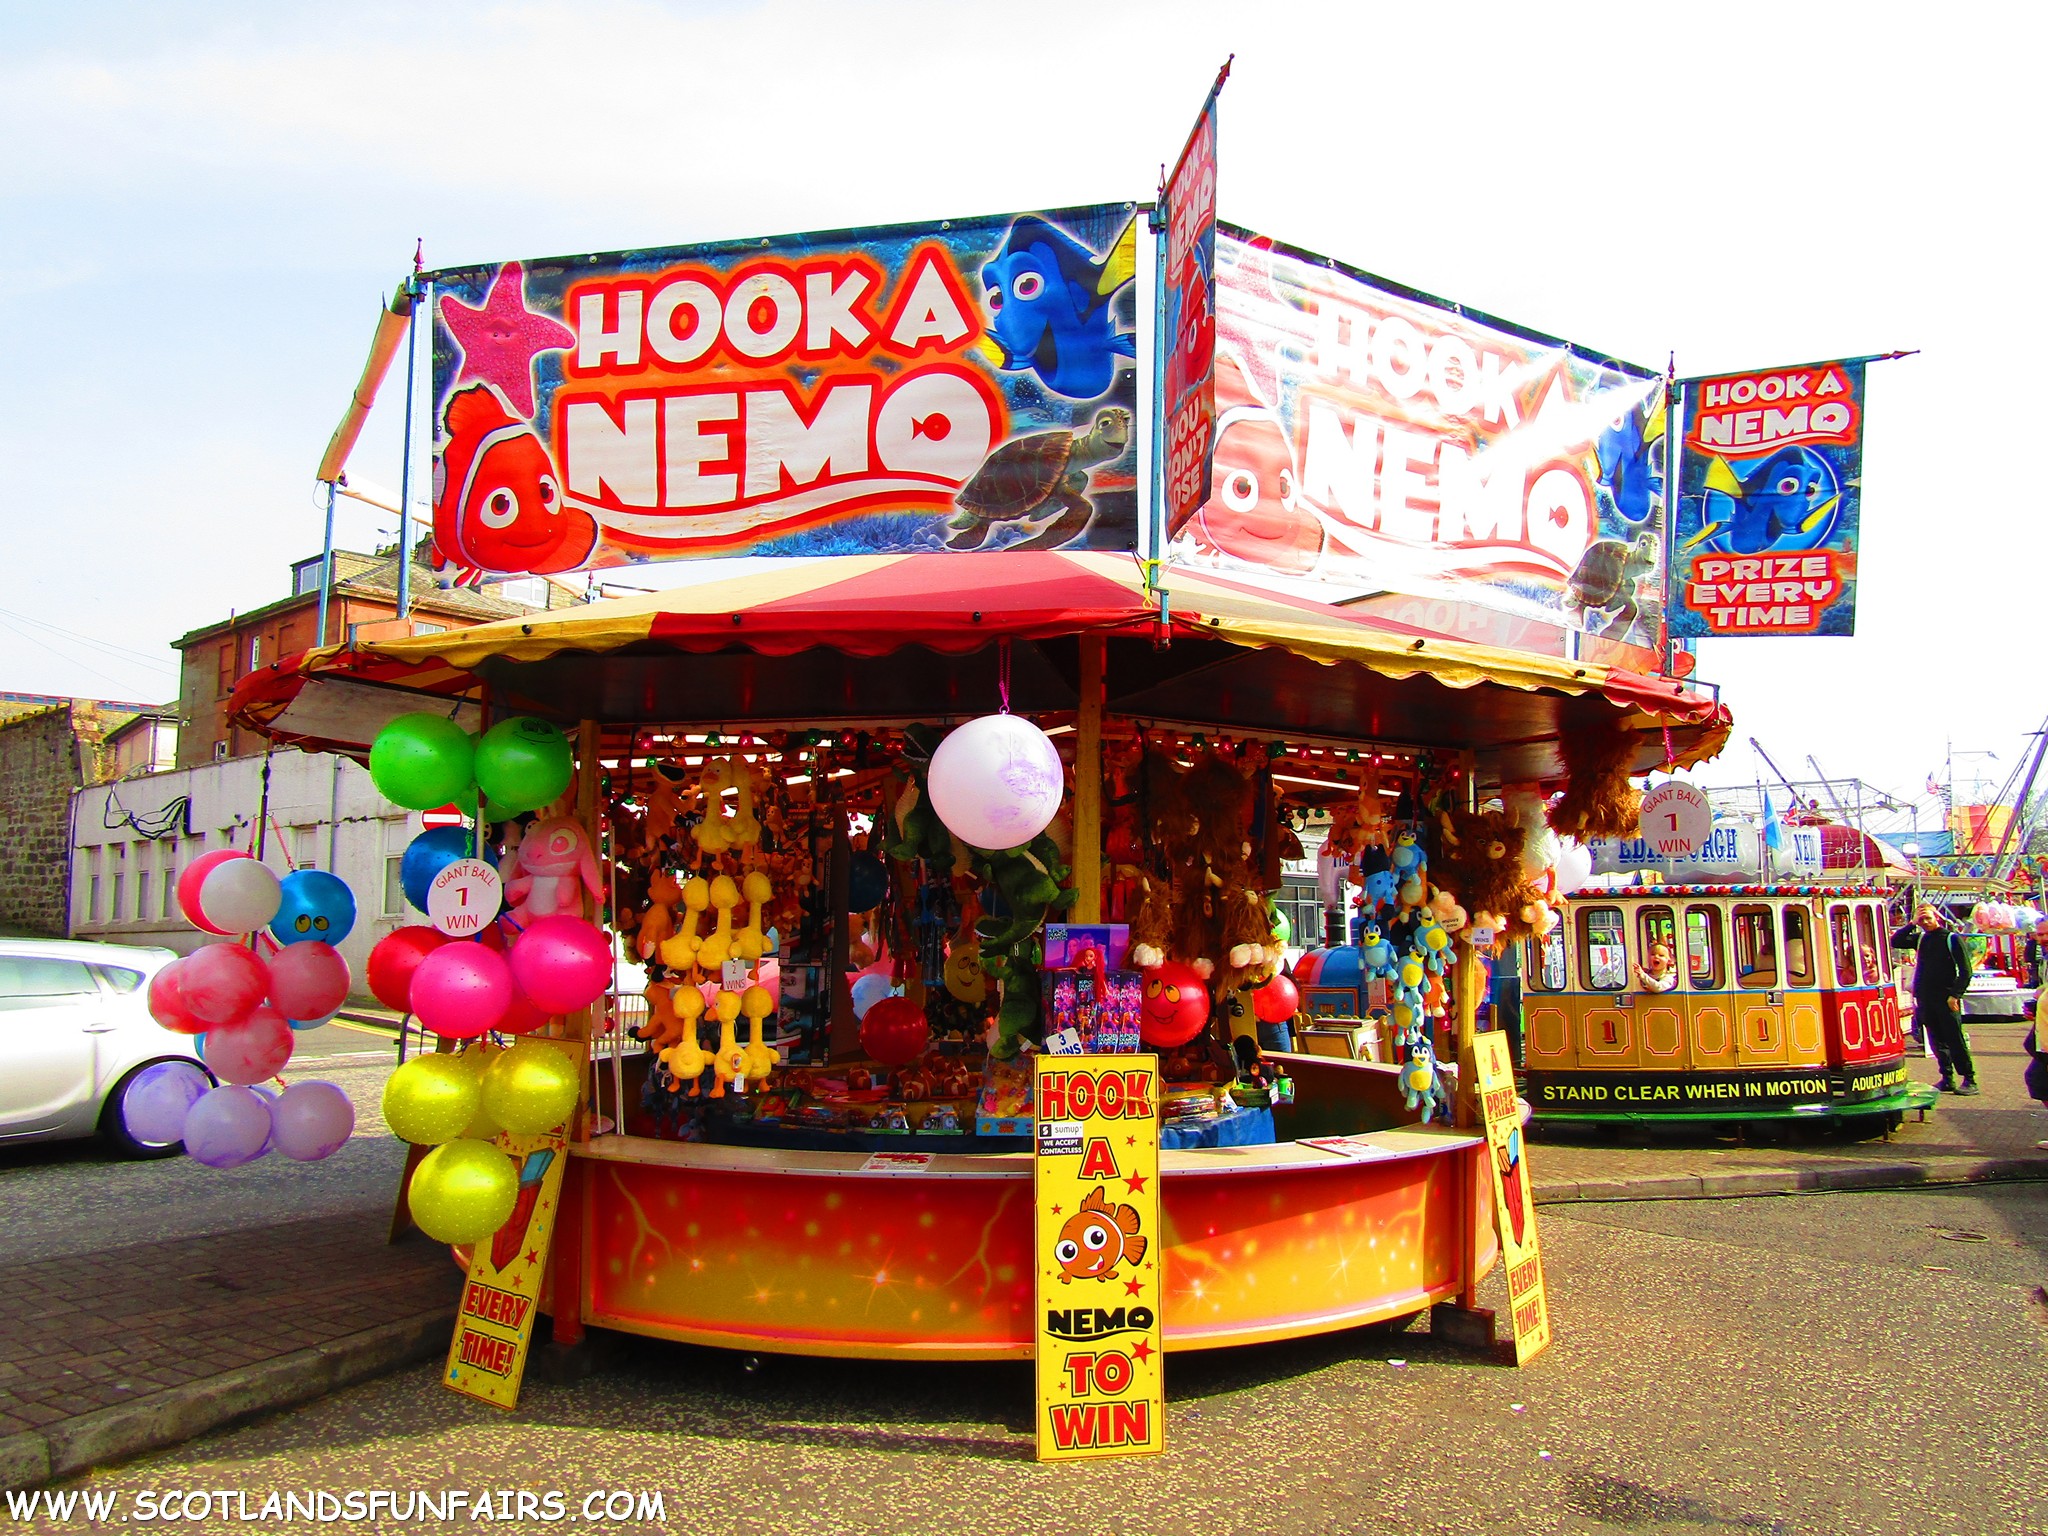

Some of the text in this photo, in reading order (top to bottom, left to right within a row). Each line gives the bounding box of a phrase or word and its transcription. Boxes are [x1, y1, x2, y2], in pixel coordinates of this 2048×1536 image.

[1201, 122, 1211, 162] A
[577, 259, 968, 370] HOOK A
[1317, 302, 1526, 434] HOOK
[1706, 370, 1843, 408] HOOK A
[1171, 397, 1199, 452] YOU
[1701, 402, 1850, 446] NEMO
[566, 373, 992, 508] NEMO
[1302, 402, 1589, 562] NEMO
[1699, 556, 1828, 582] PRIZE
[1693, 580, 1833, 604] EVERY
[1710, 606, 1810, 627] TIME
[1643, 789, 1702, 813] GIANT BALL
[1664, 813, 1679, 831] 1
[1658, 838, 1691, 852] WIN
[435, 866, 496, 889] GIANT BALL
[455, 887, 470, 906] 1
[446, 913, 479, 929] WIN
[732, 964, 737, 974] 2
[726, 979, 746, 989] WINS
[1602, 1020, 1616, 1043] 1
[1756, 1017, 1770, 1041] 1
[1873, 1011, 1880, 1032] 1
[1052, 1043, 1081, 1055] INS
[1058, 1034, 1066, 1045] 3
[1490, 1045, 1501, 1076] A
[1544, 1079, 1827, 1101] STAND CLEAR WHEN IN MOTION
[1852, 1073, 1882, 1092] ADULTS
[1883, 1070, 1895, 1087] MAY
[1039, 1070, 1154, 1122] HOOK
[1485, 1086, 1517, 1123] PRIZE
[1054, 1126, 1080, 1135] sumup
[1040, 1147, 1082, 1155] CONTACTLESS
[1078, 1137, 1120, 1180] A
[1509, 1253, 1538, 1301] EVERY
[463, 1280, 532, 1331] EVERY
[1515, 1294, 1541, 1339] TIME!
[1048, 1306, 1154, 1335] NEMO
[459, 1327, 517, 1379] TIME!
[1064, 1351, 1134, 1397] TO
[1049, 1400, 1150, 1450] WIN
